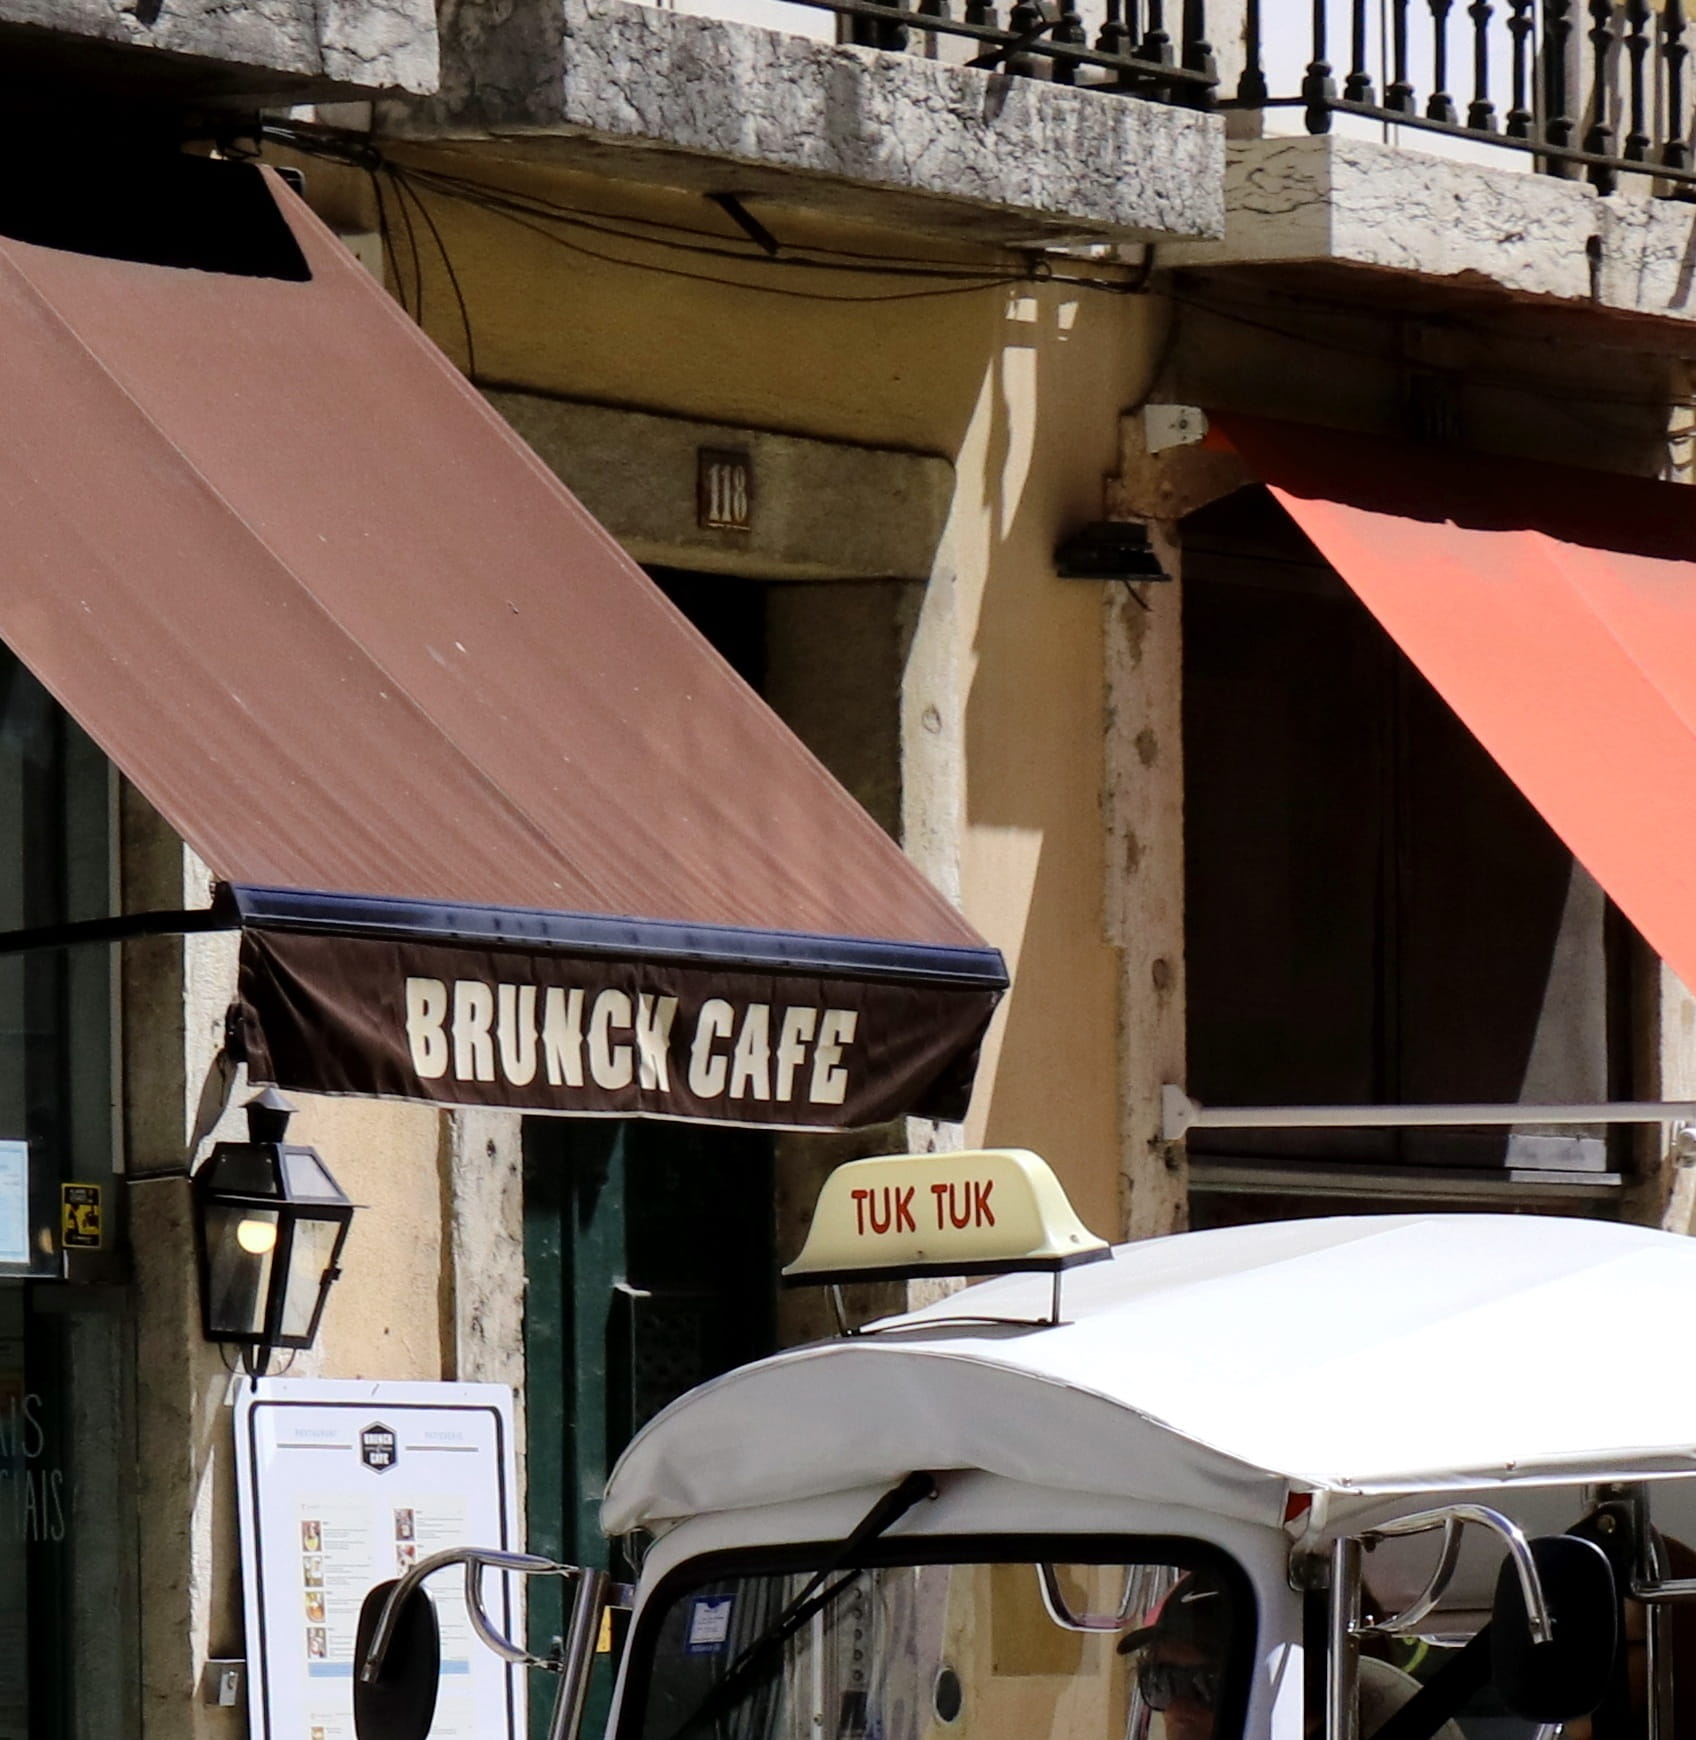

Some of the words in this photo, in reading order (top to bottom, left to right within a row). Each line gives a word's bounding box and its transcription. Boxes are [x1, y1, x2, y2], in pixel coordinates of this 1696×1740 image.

[708, 463, 747, 522] 118
[404, 976, 680, 1093] BRUNCH
[688, 996, 858, 1105] CAFE
[850, 1185, 916, 1236] TUK
[930, 1179, 996, 1231] TUK
